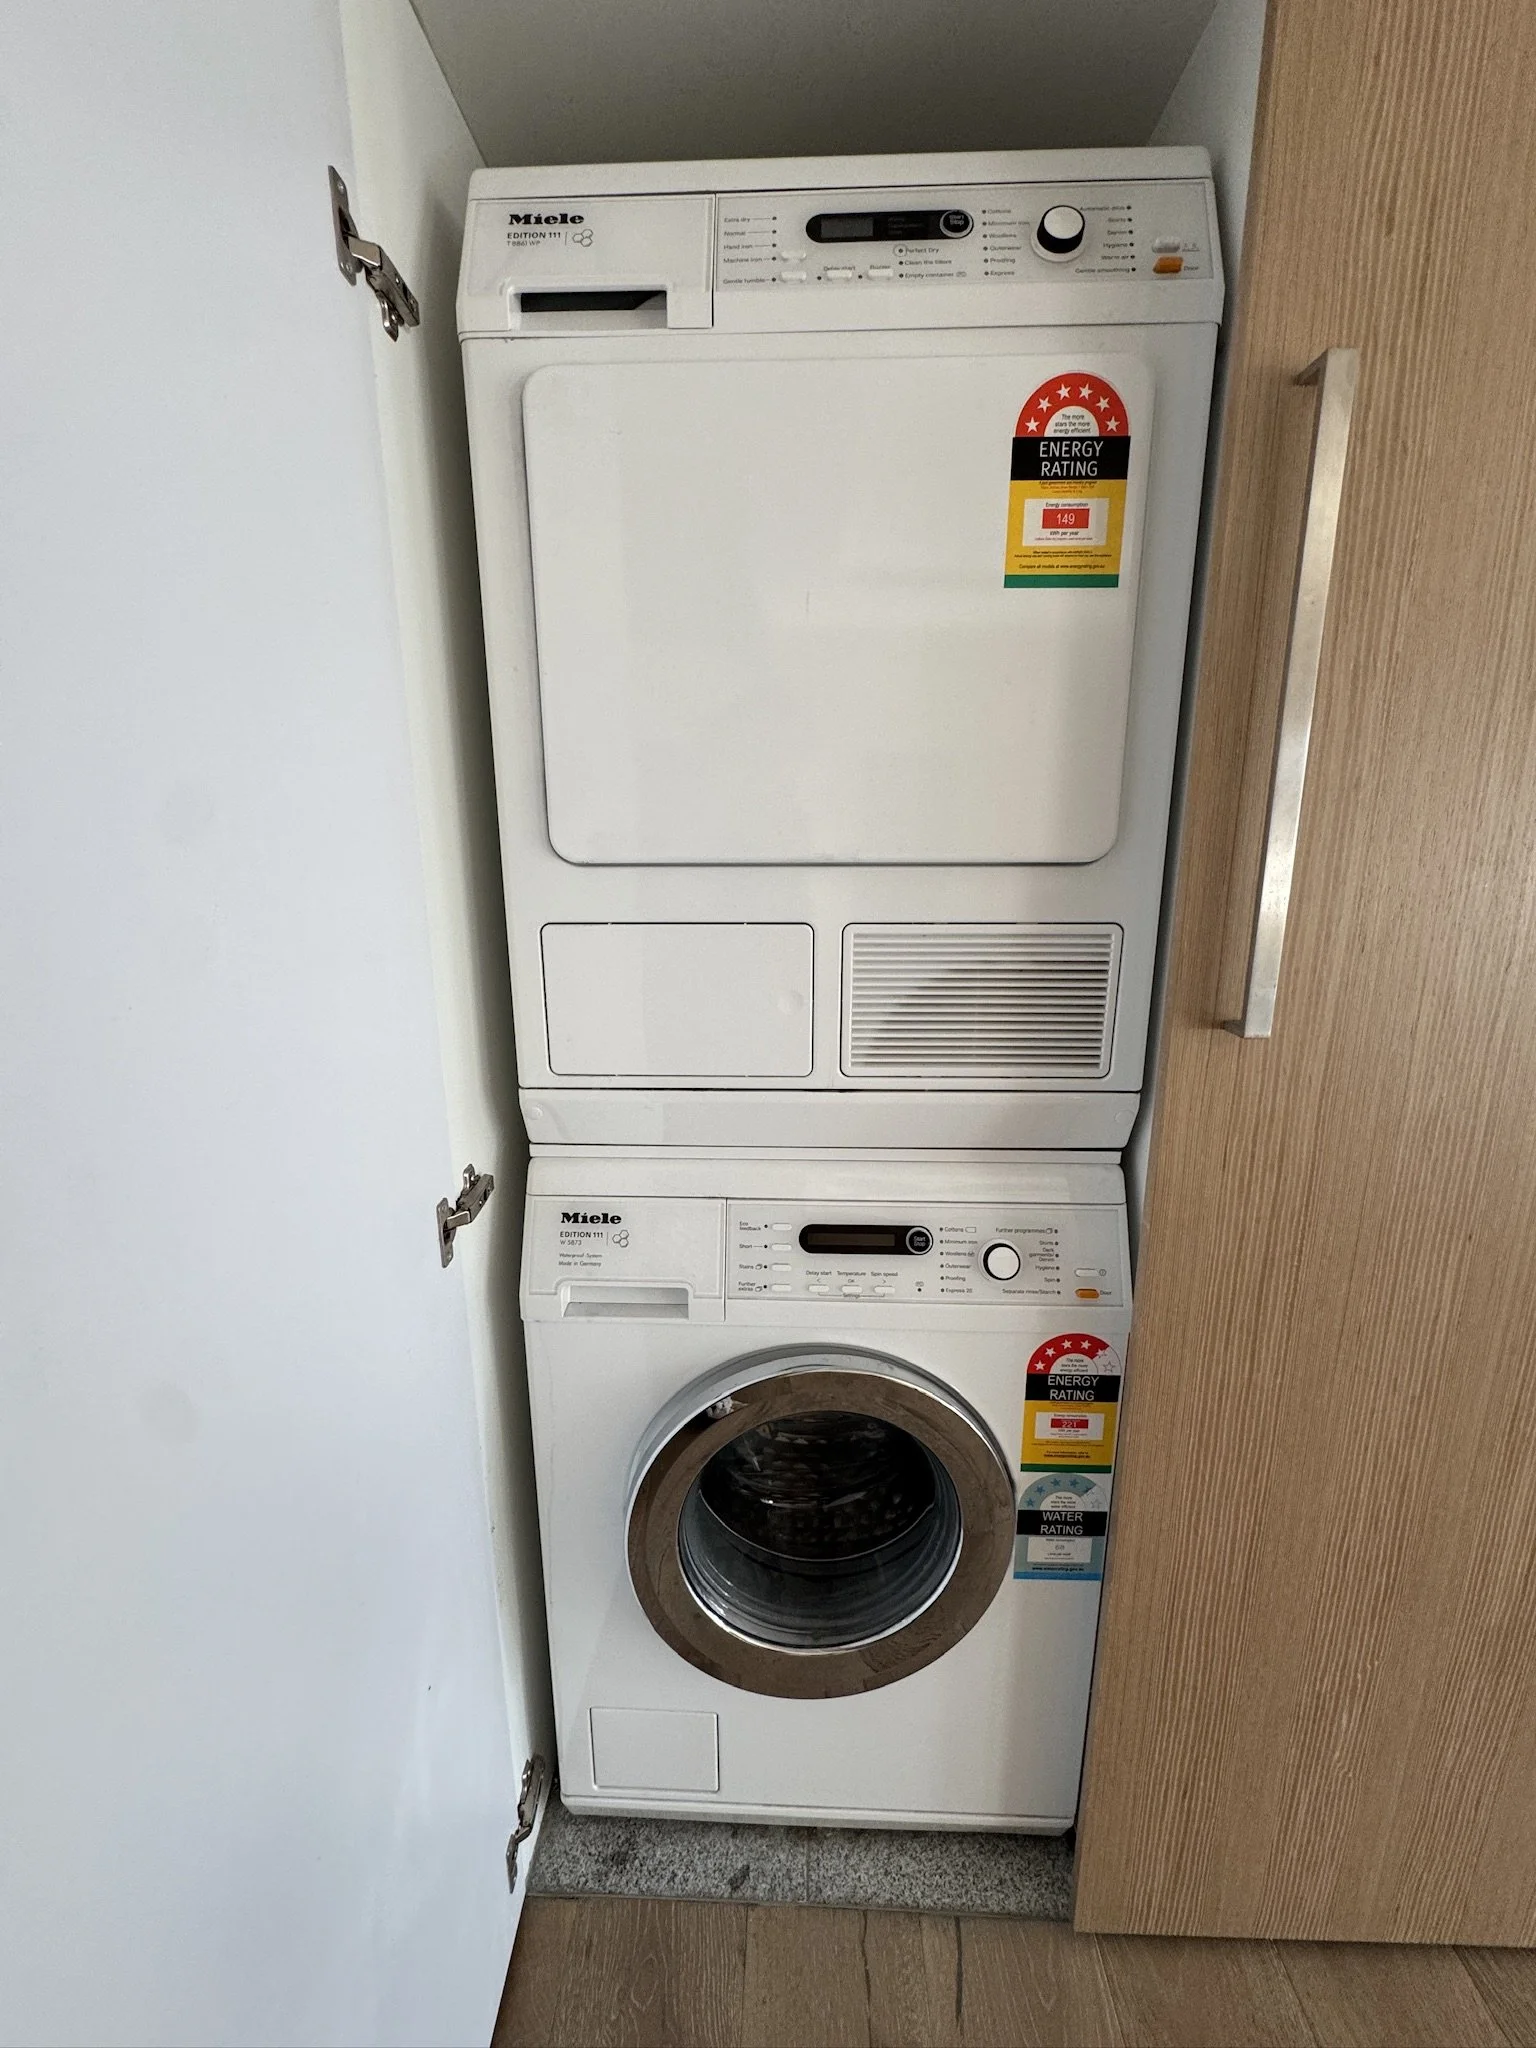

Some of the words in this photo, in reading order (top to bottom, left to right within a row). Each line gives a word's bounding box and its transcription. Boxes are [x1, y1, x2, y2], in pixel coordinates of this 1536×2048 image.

[508, 213, 584, 225] Miele
[1040, 441, 1104, 457] ENERGY
[1041, 461, 1098, 476] RATING
[1057, 513, 1075, 525] 149
[561, 1212, 622, 1224] Miele
[1048, 1375, 1099, 1386] ENERGY
[1050, 1390, 1095, 1400] RATING
[1042, 1512, 1083, 1522] WATER
[1040, 1525, 1083, 1535] RATING
